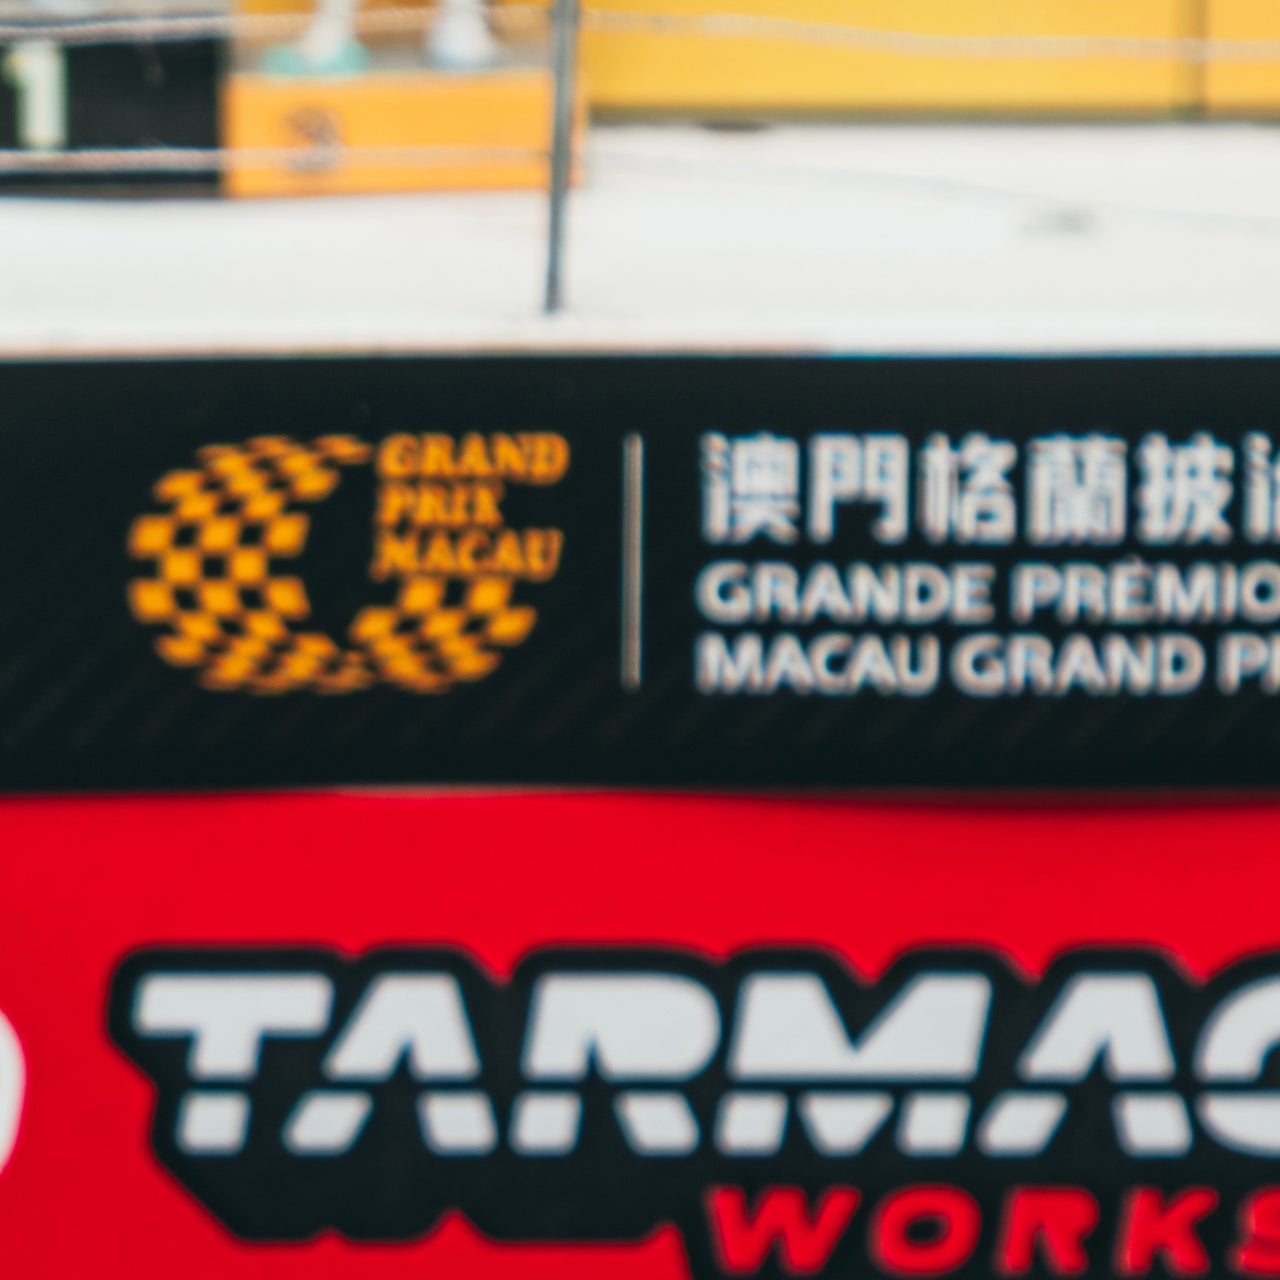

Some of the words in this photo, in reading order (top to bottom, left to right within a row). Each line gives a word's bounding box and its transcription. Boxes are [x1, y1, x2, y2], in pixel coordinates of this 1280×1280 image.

[2, 38, 68, 156] 1
[376, 433, 570, 484] GRAND
[698, 432, 1280, 544] 澳門格蘭披
[376, 483, 504, 529] PRIX
[372, 528, 565, 582] MACAU
[697, 561, 996, 624] GRANDE
[696, 633, 940, 694] MACAU
[950, 633, 1206, 696] GRAND
[1217, 633, 1280, 694] P
